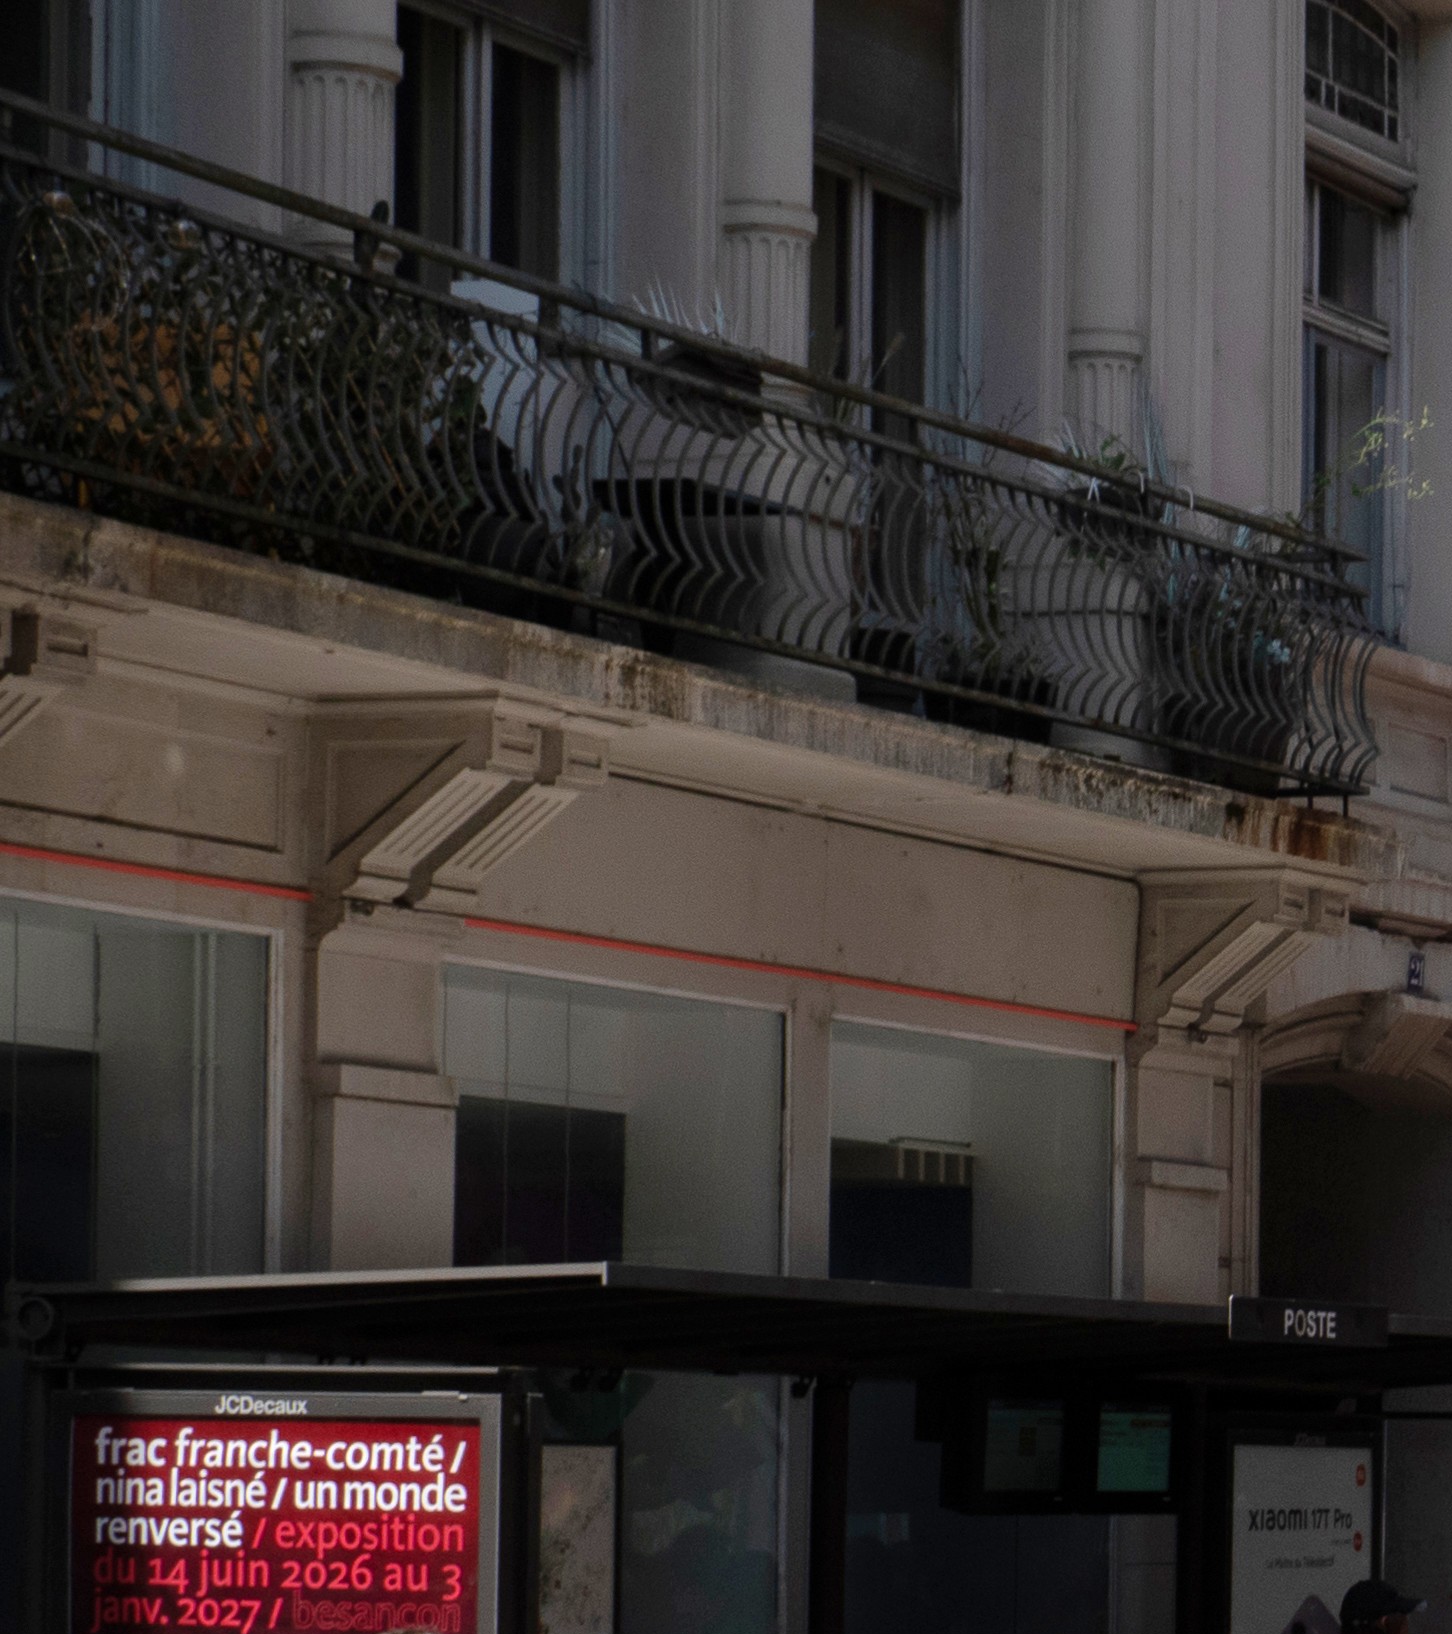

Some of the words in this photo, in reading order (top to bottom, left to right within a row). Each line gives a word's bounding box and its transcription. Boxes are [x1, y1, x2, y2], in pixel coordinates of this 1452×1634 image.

[1284, 1309, 1337, 1339] POSTE
[215, 1395, 308, 1416] JCDecaux
[95, 1426, 167, 1467] frac
[175, 1427, 446, 1472] franche-comté
[95, 1469, 164, 1507] nina
[170, 1467, 267, 1508] laisné
[294, 1480, 337, 1510] un
[343, 1472, 468, 1512] monde
[95, 1510, 243, 1547] renversé
[275, 1513, 464, 1559] exposition
[1311, 1508, 1331, 1531] 17T
[1333, 1508, 1353, 1530] Pro
[93, 1546, 136, 1584] du
[148, 1556, 189, 1595] 14
[196, 1550, 270, 1597] juin
[280, 1553, 373, 1591] 2026
[383, 1560, 428, 1592] au
[441, 1563, 462, 1601] 3
[91, 1588, 169, 1634] janv.
